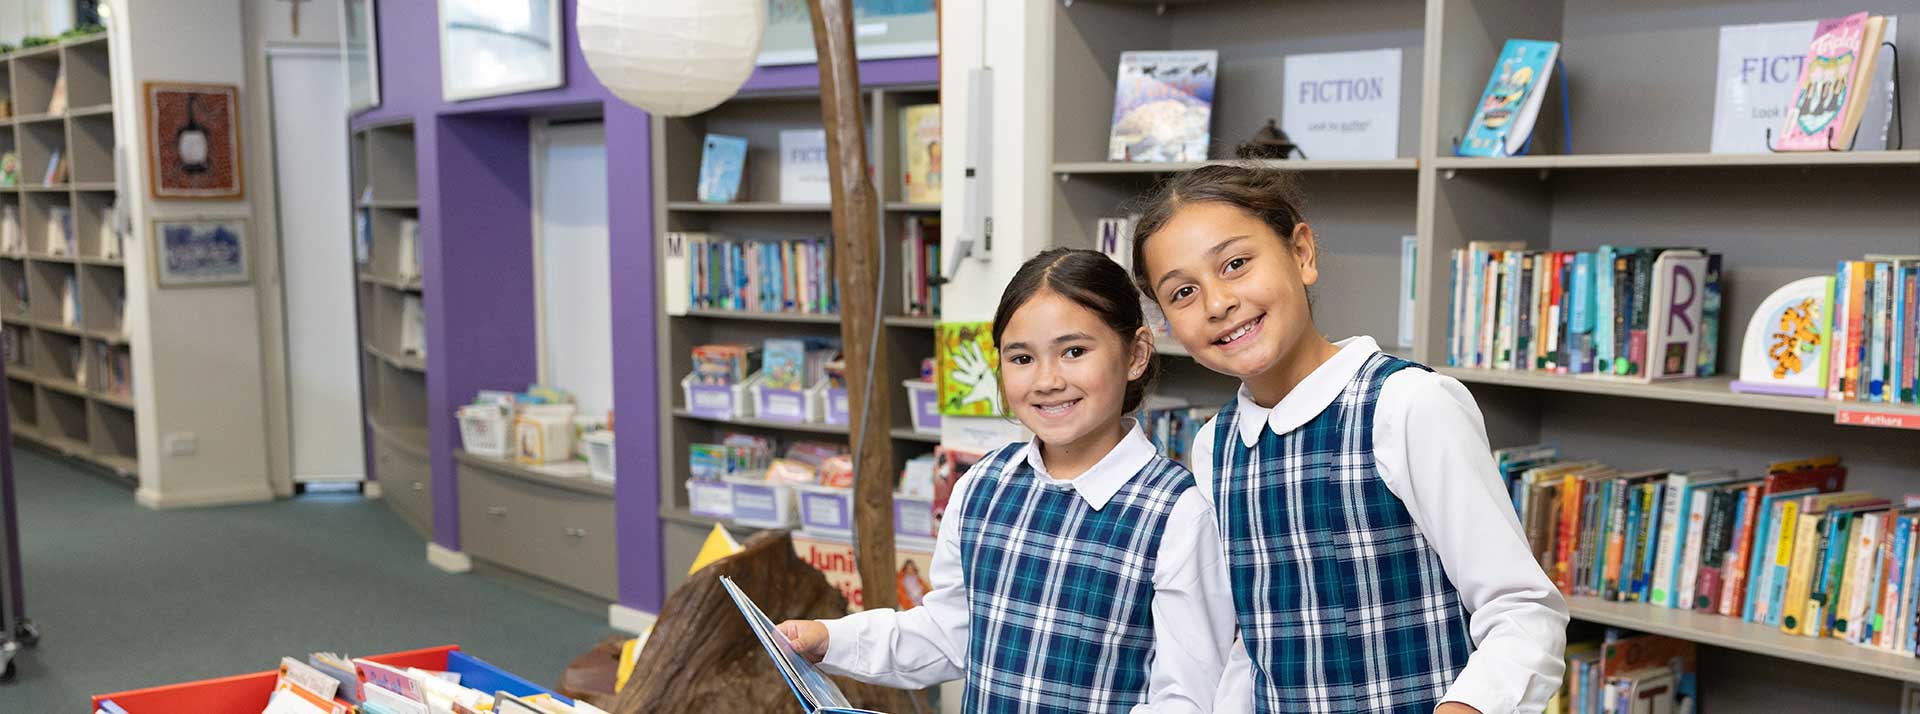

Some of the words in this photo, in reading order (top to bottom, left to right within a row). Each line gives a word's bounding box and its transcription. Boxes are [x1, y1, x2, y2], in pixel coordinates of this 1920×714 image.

[1741, 55, 1808, 84] FICT
[1299, 77, 1384, 104] FICTION
[792, 147, 827, 164] FICT
[1102, 222, 1118, 254] N
[1668, 264, 1695, 336] R
[802, 546, 856, 573] Juni
